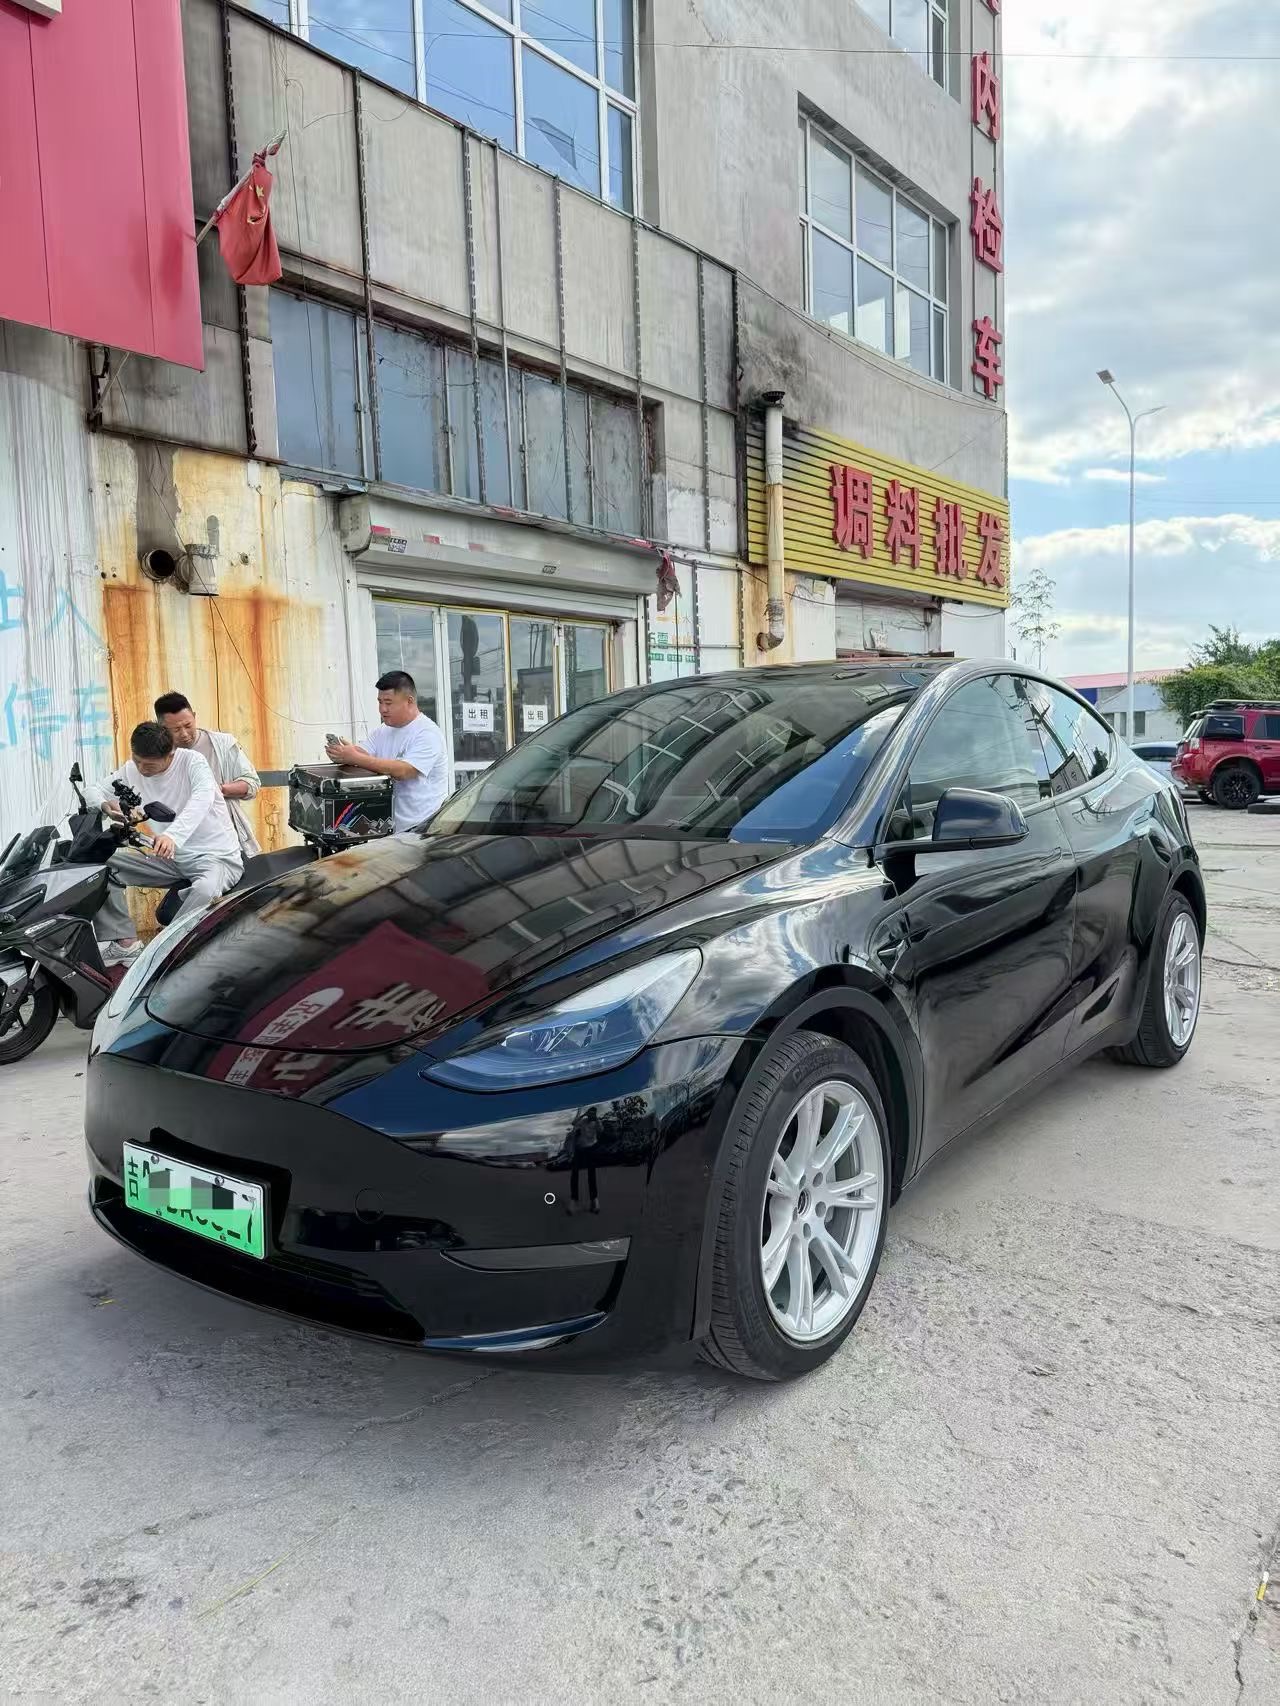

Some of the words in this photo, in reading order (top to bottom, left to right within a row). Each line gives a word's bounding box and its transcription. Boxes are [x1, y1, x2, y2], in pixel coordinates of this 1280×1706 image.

[828, 463, 1006, 588] 调料批发
[468, 708, 489, 720] 出租
[527, 710, 544, 721] 出租
